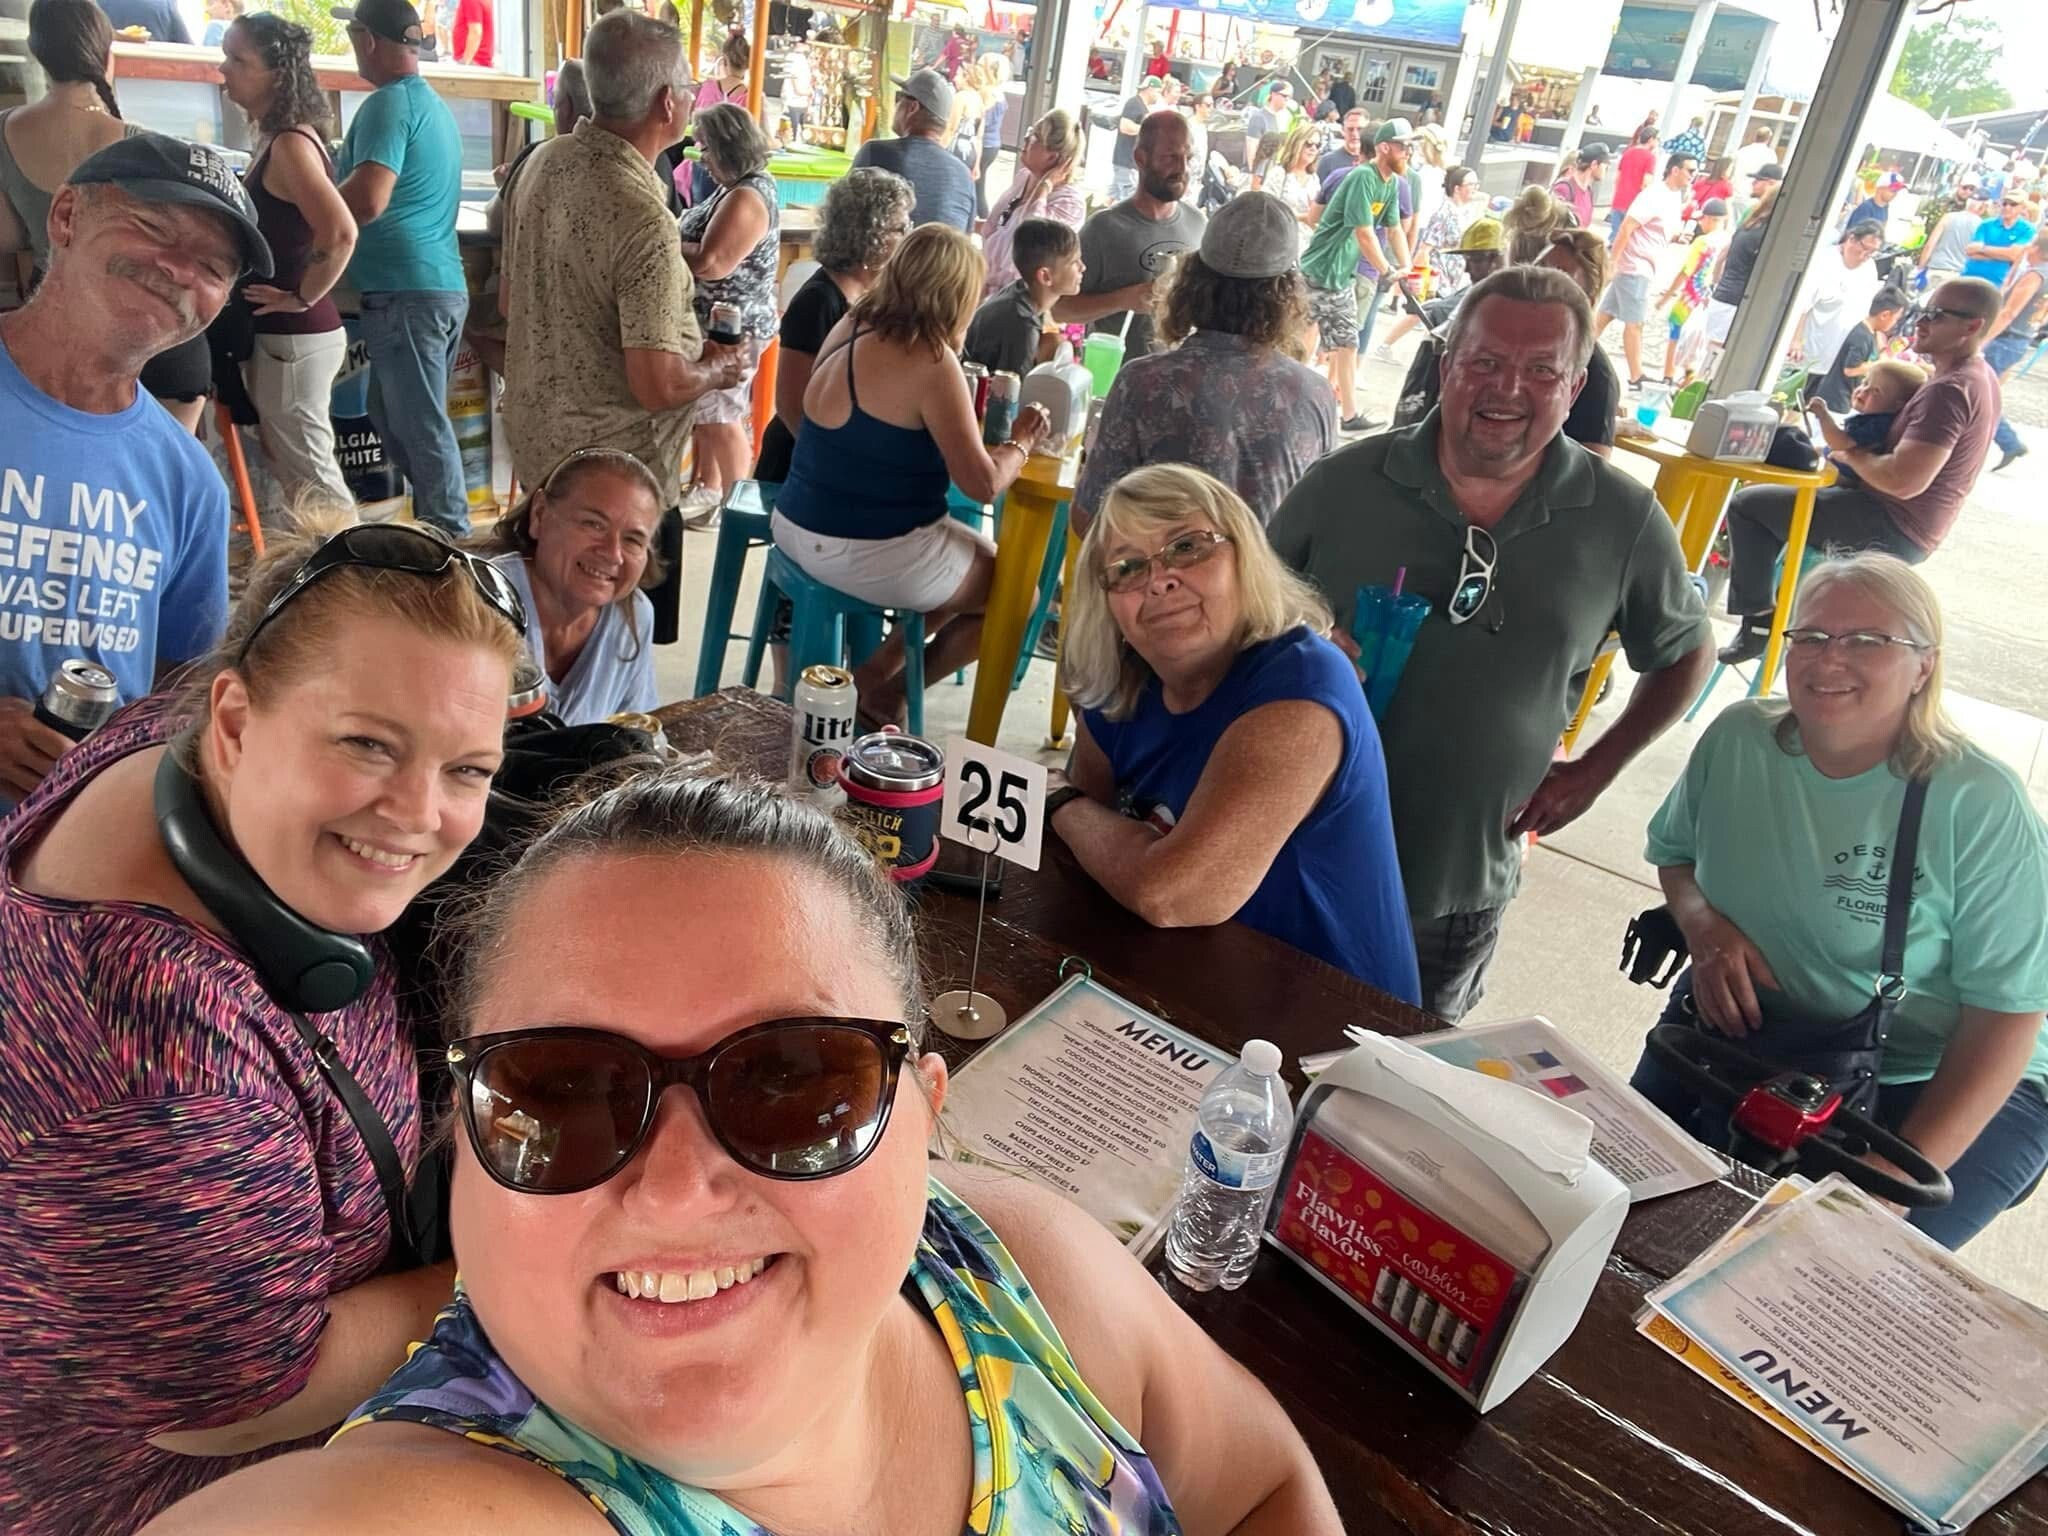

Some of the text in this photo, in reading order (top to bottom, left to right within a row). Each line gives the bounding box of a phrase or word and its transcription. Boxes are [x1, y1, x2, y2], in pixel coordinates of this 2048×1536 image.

[337, 431, 382, 448] LGIA
[0, 468, 147, 538] N MY
[0, 519, 162, 591] EFENSE
[77, 584, 140, 621] LEFT
[0, 611, 139, 652] UPERVISED
[802, 711, 852, 746] Lite
[957, 760, 1028, 844] 25
[1115, 1019, 1208, 1071] MENU
[1296, 1181, 1383, 1257] Flawliss
[1300, 1206, 1365, 1267] flavor.
[1402, 1252, 1473, 1304] carbliss
[1740, 1346, 1871, 1441] MENU
